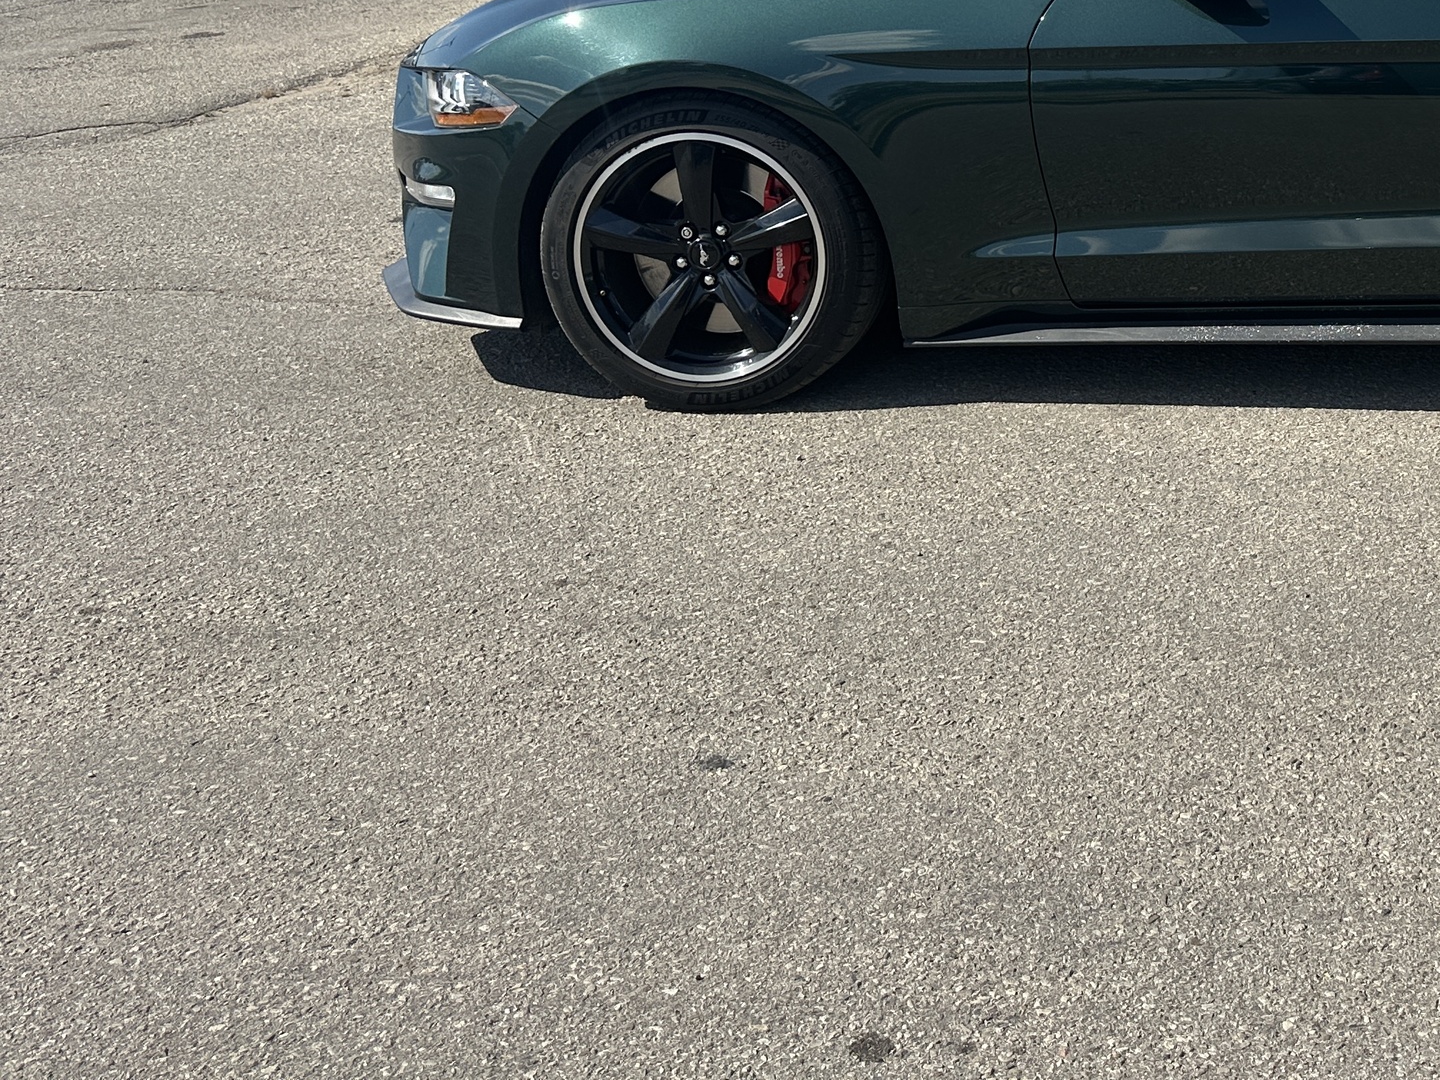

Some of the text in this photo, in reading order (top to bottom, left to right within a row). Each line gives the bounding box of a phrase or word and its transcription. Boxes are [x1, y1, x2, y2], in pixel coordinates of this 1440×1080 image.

[605, 110, 702, 150] MICHELIN
[775, 244, 786, 279] rembo
[693, 368, 790, 405] MICHELIN
